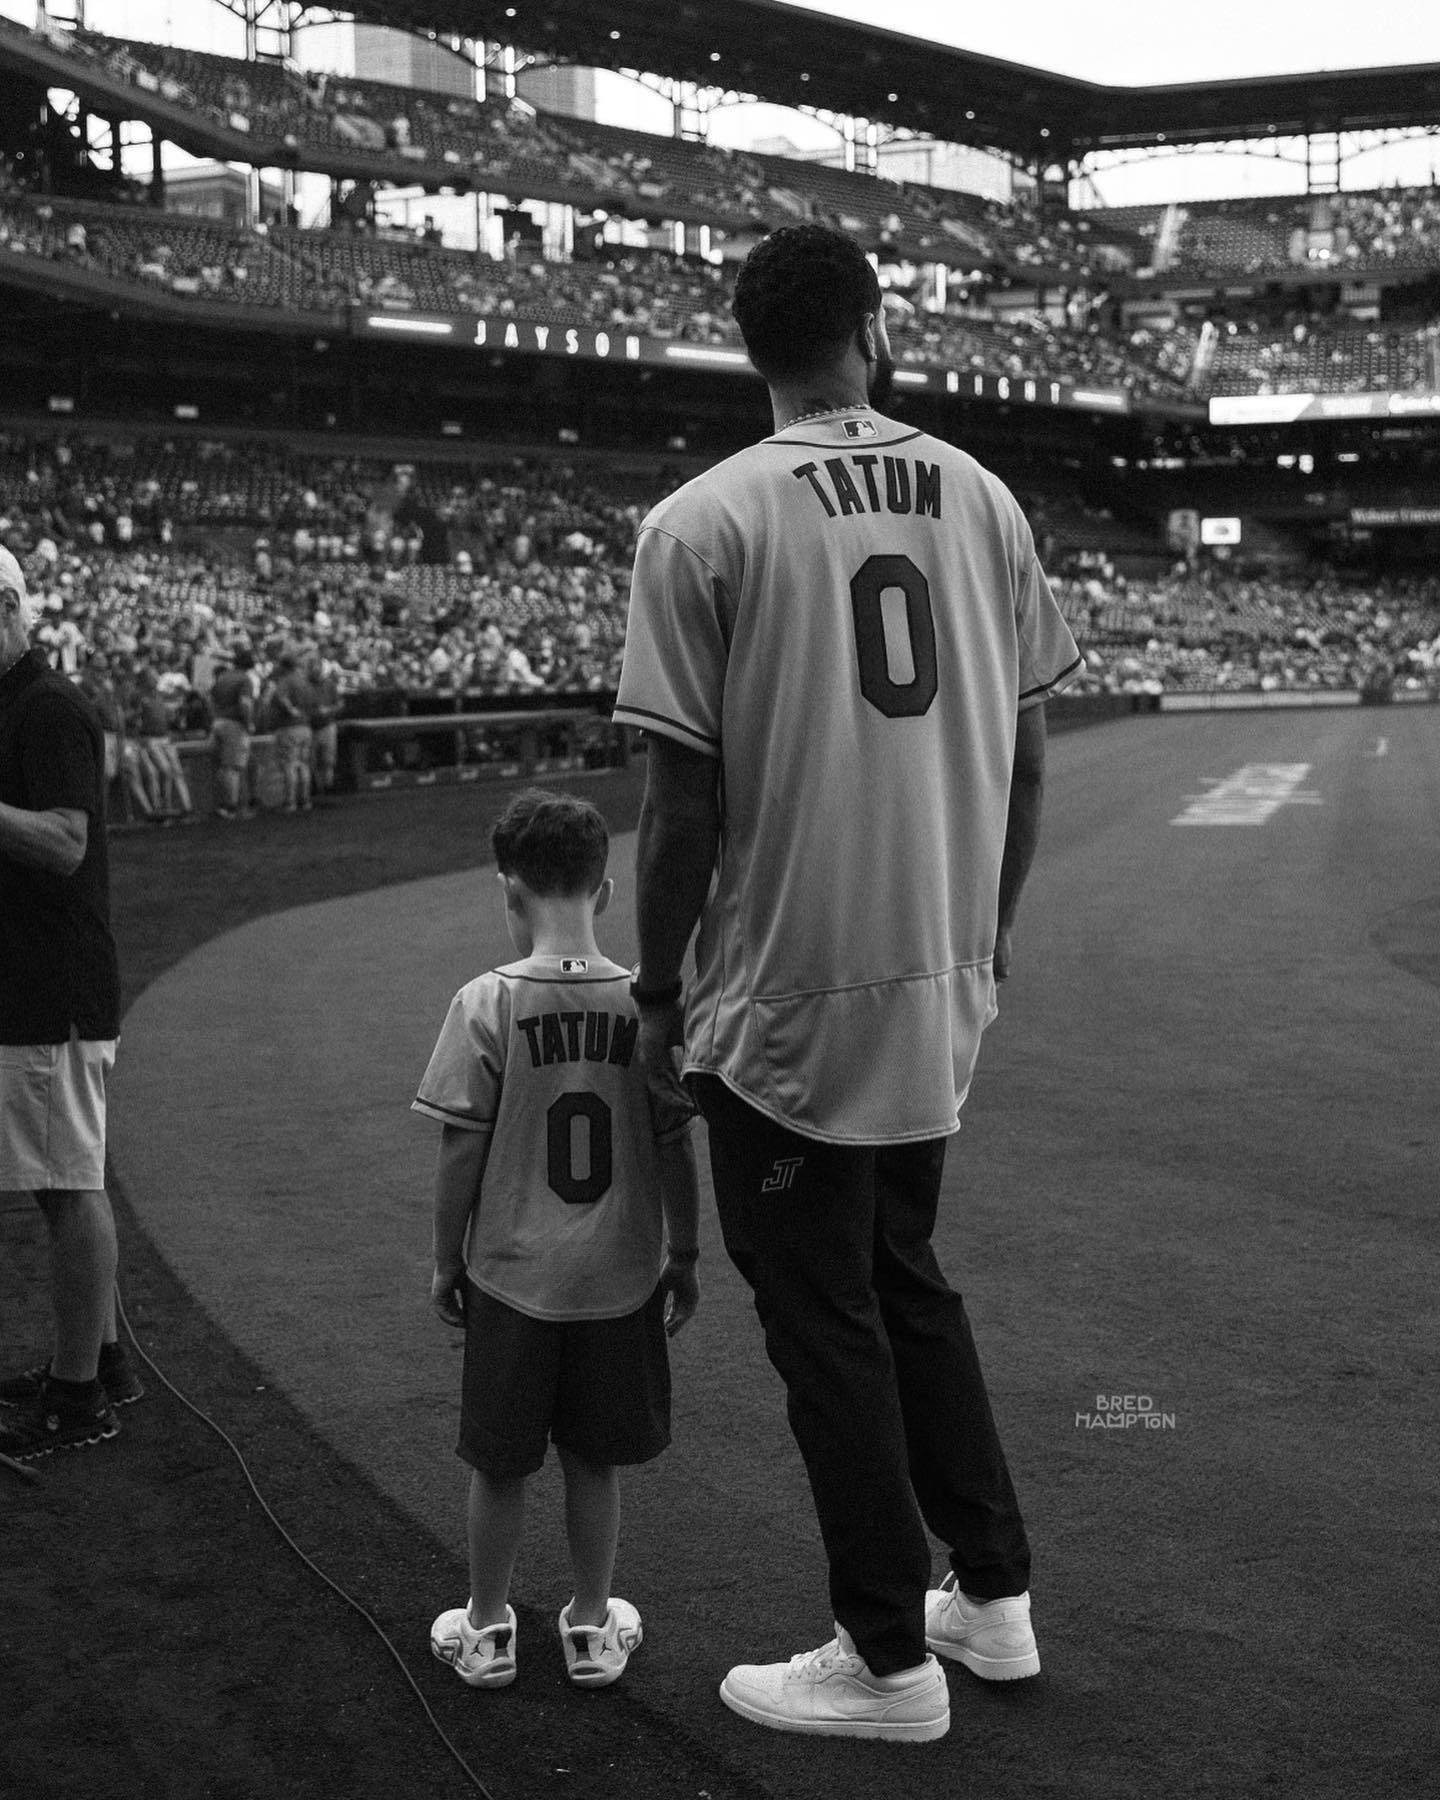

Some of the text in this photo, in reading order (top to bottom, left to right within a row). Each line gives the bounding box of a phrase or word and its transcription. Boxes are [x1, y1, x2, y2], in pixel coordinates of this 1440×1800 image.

[474, 319, 639, 359] JAYSON
[792, 455, 941, 519] TATUM
[850, 554, 938, 718] 0
[517, 1011, 639, 1068] TATUM
[547, 1091, 612, 1204] 0
[761, 1156, 804, 1192] JT
